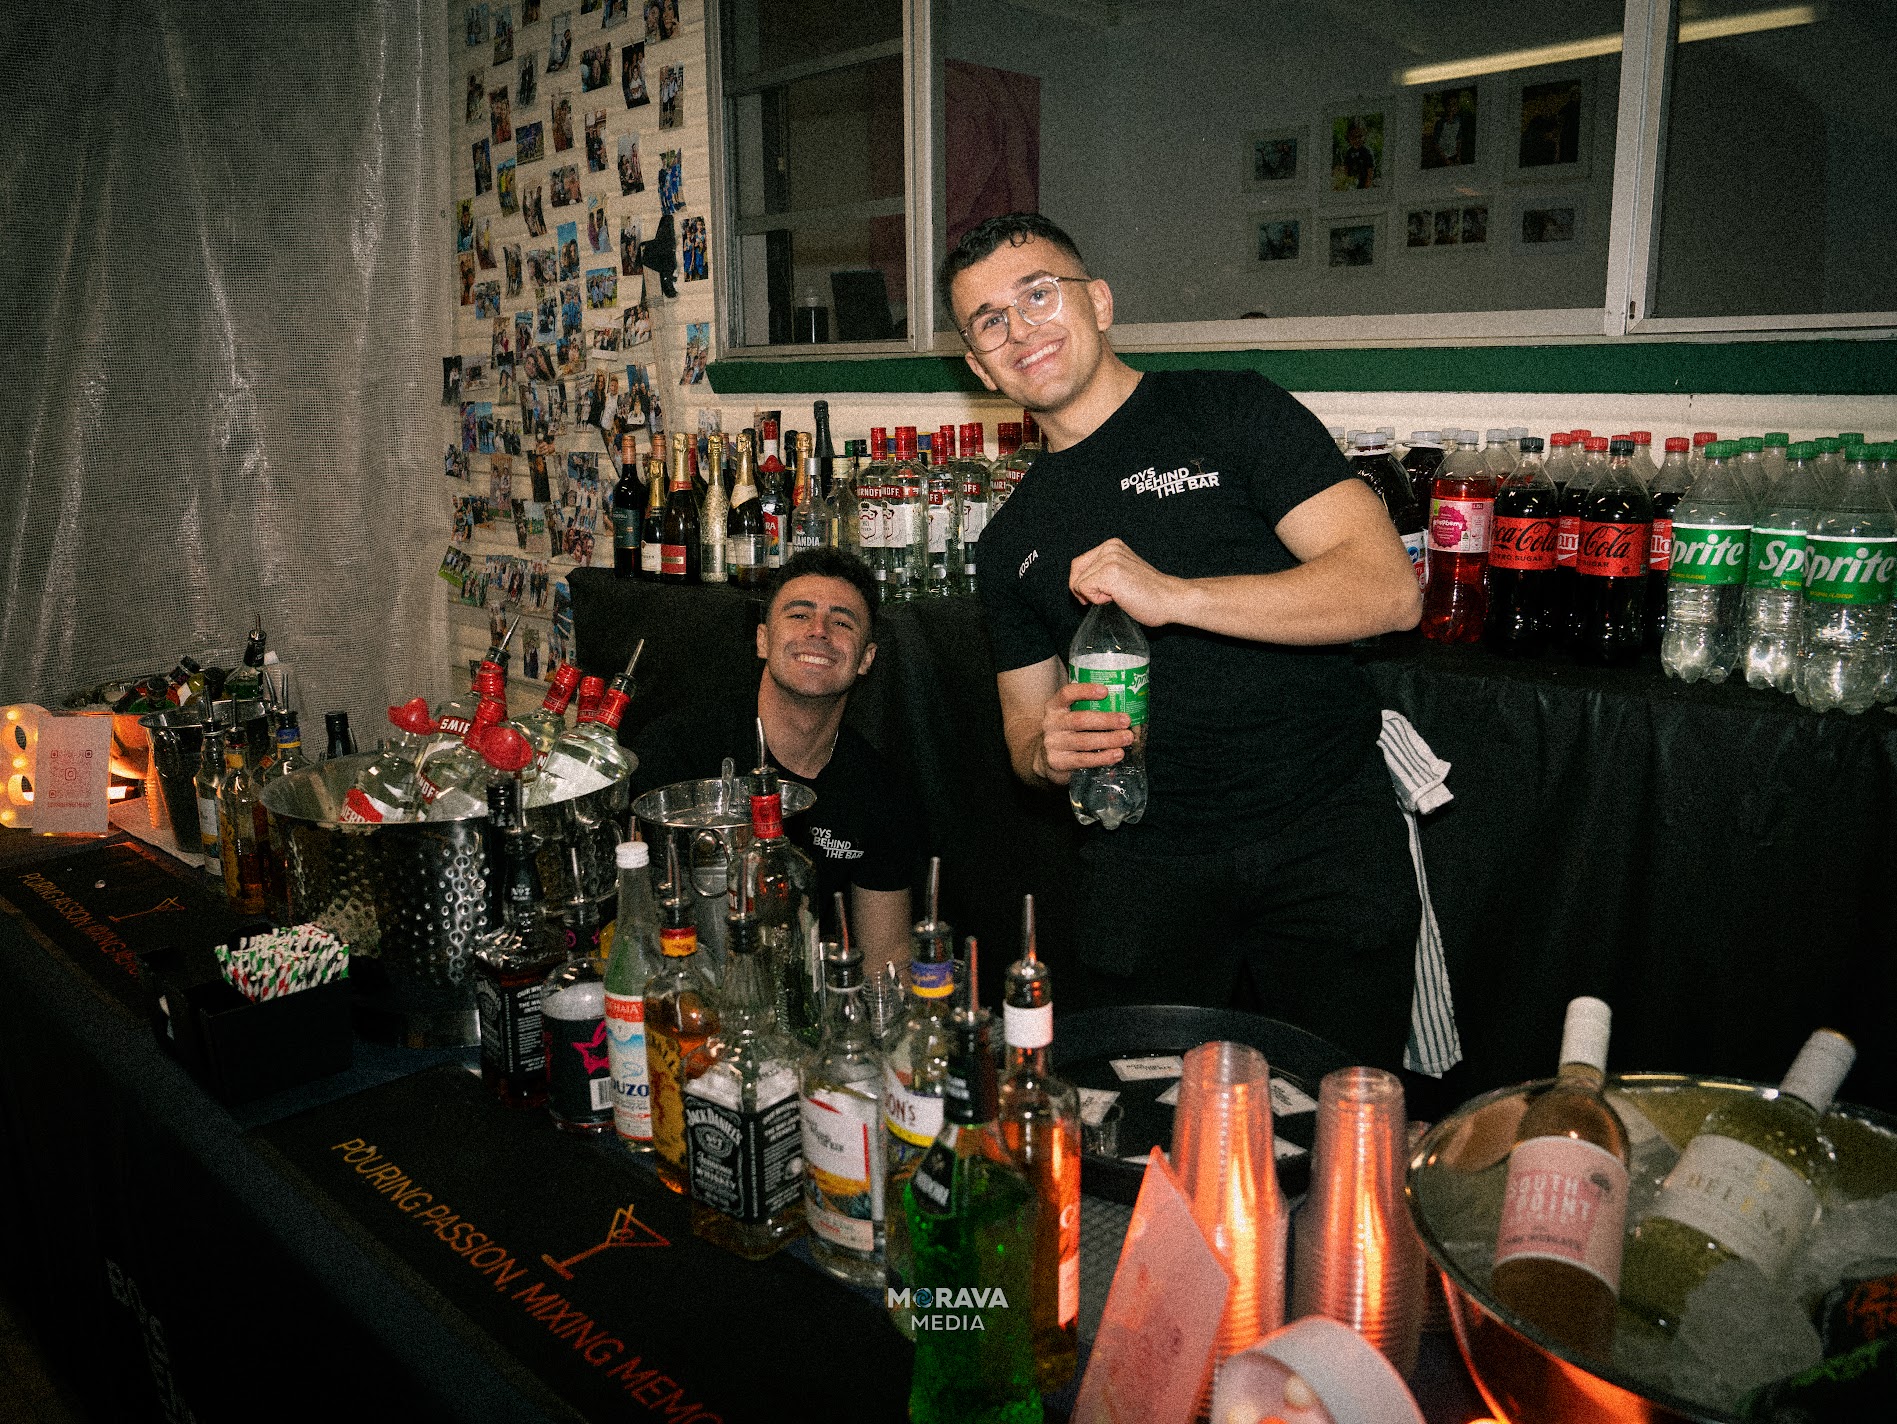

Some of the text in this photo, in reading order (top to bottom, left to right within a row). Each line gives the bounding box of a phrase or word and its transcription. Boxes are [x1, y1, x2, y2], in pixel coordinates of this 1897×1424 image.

[1120, 467, 1156, 491] BOYS
[1135, 467, 1190, 495] BEHIND
[1156, 475, 1221, 499] THE BAR
[809, 826, 832, 839] OYS
[813, 836, 852, 850] BEHIND
[825, 848, 845, 859] THE
[331, 1137, 433, 1213] POURING
[511, 1281, 625, 1368] MIXING
